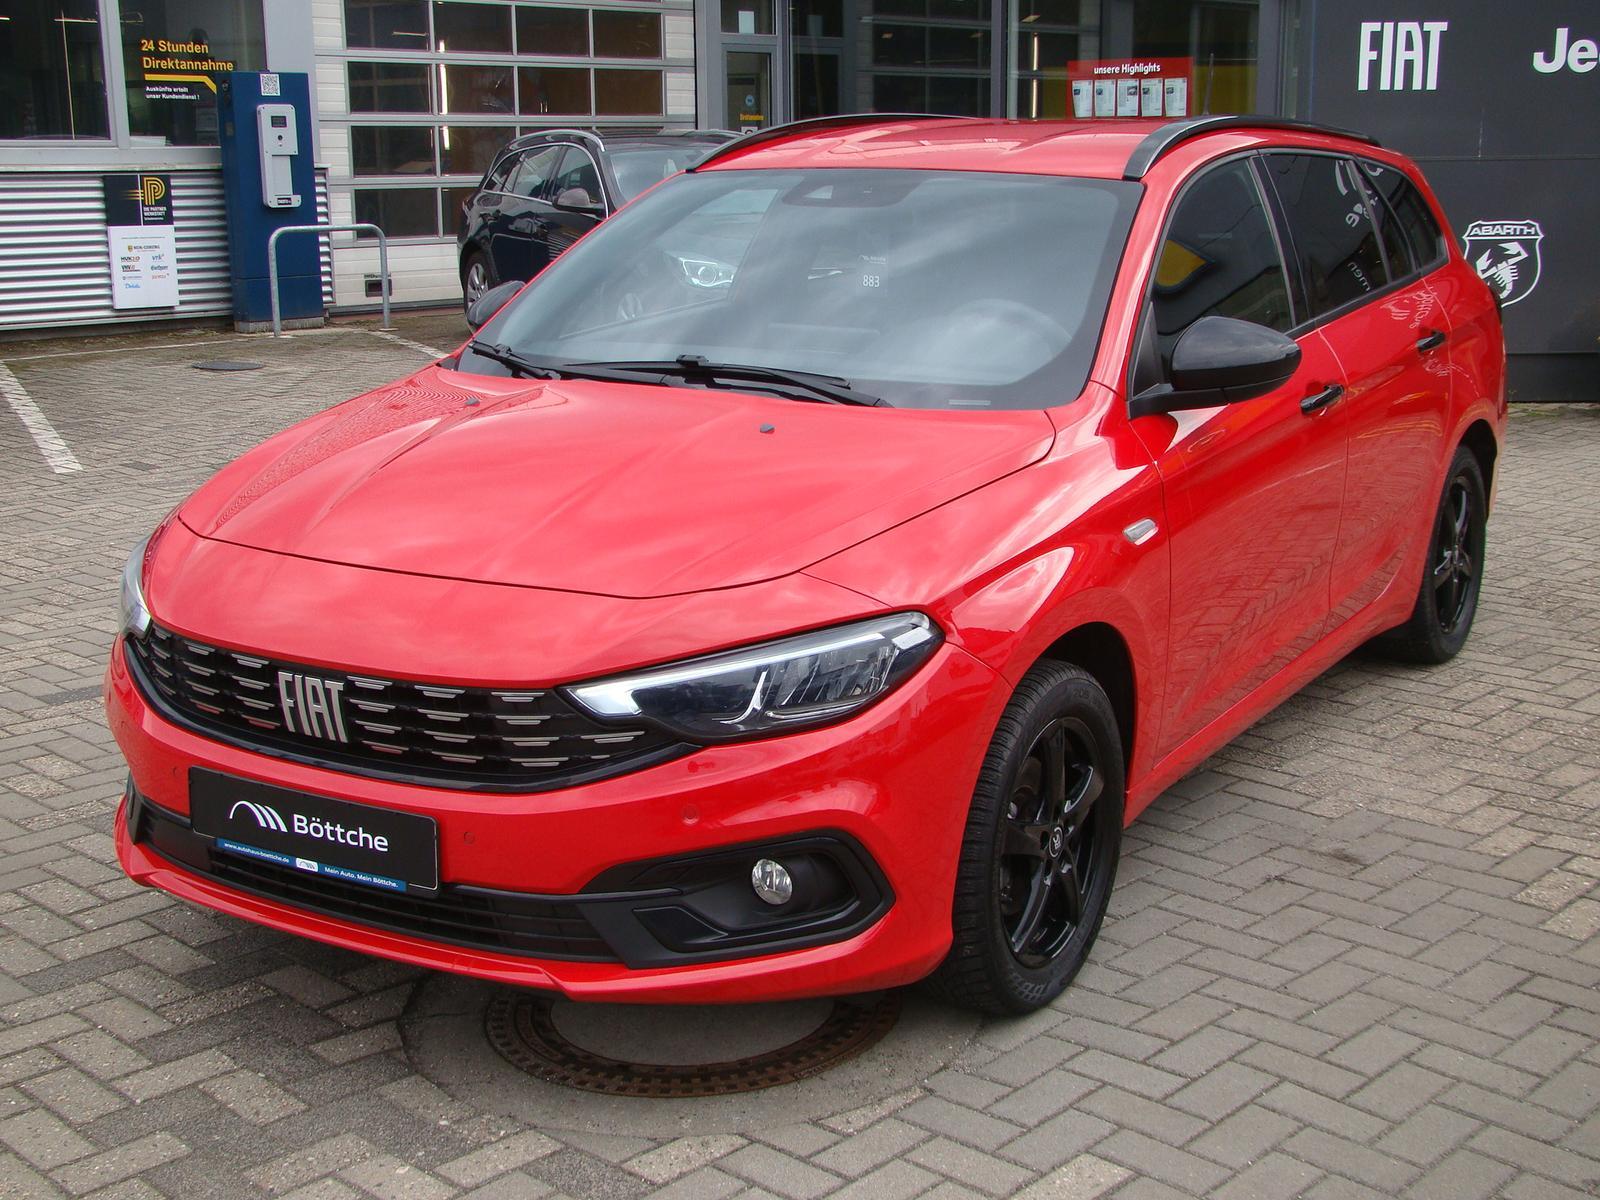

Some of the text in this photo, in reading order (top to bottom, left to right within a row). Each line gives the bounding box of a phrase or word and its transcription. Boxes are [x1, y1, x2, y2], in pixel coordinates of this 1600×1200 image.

[141, 39, 209, 54] 24 Stunden
[1357, 21, 1449, 91] FIAT
[1532, 27, 1600, 74] Je
[142, 56, 234, 71] Direktannahme
[1093, 62, 1161, 76] unsere Highlights
[1469, 224, 1537, 236] ABARTH
[862, 274, 880, 288] 883
[277, 671, 349, 744] FIAT
[292, 813, 390, 852] Böttche
[324, 866, 399, 889] Mein Auto. Mein Böttche.
